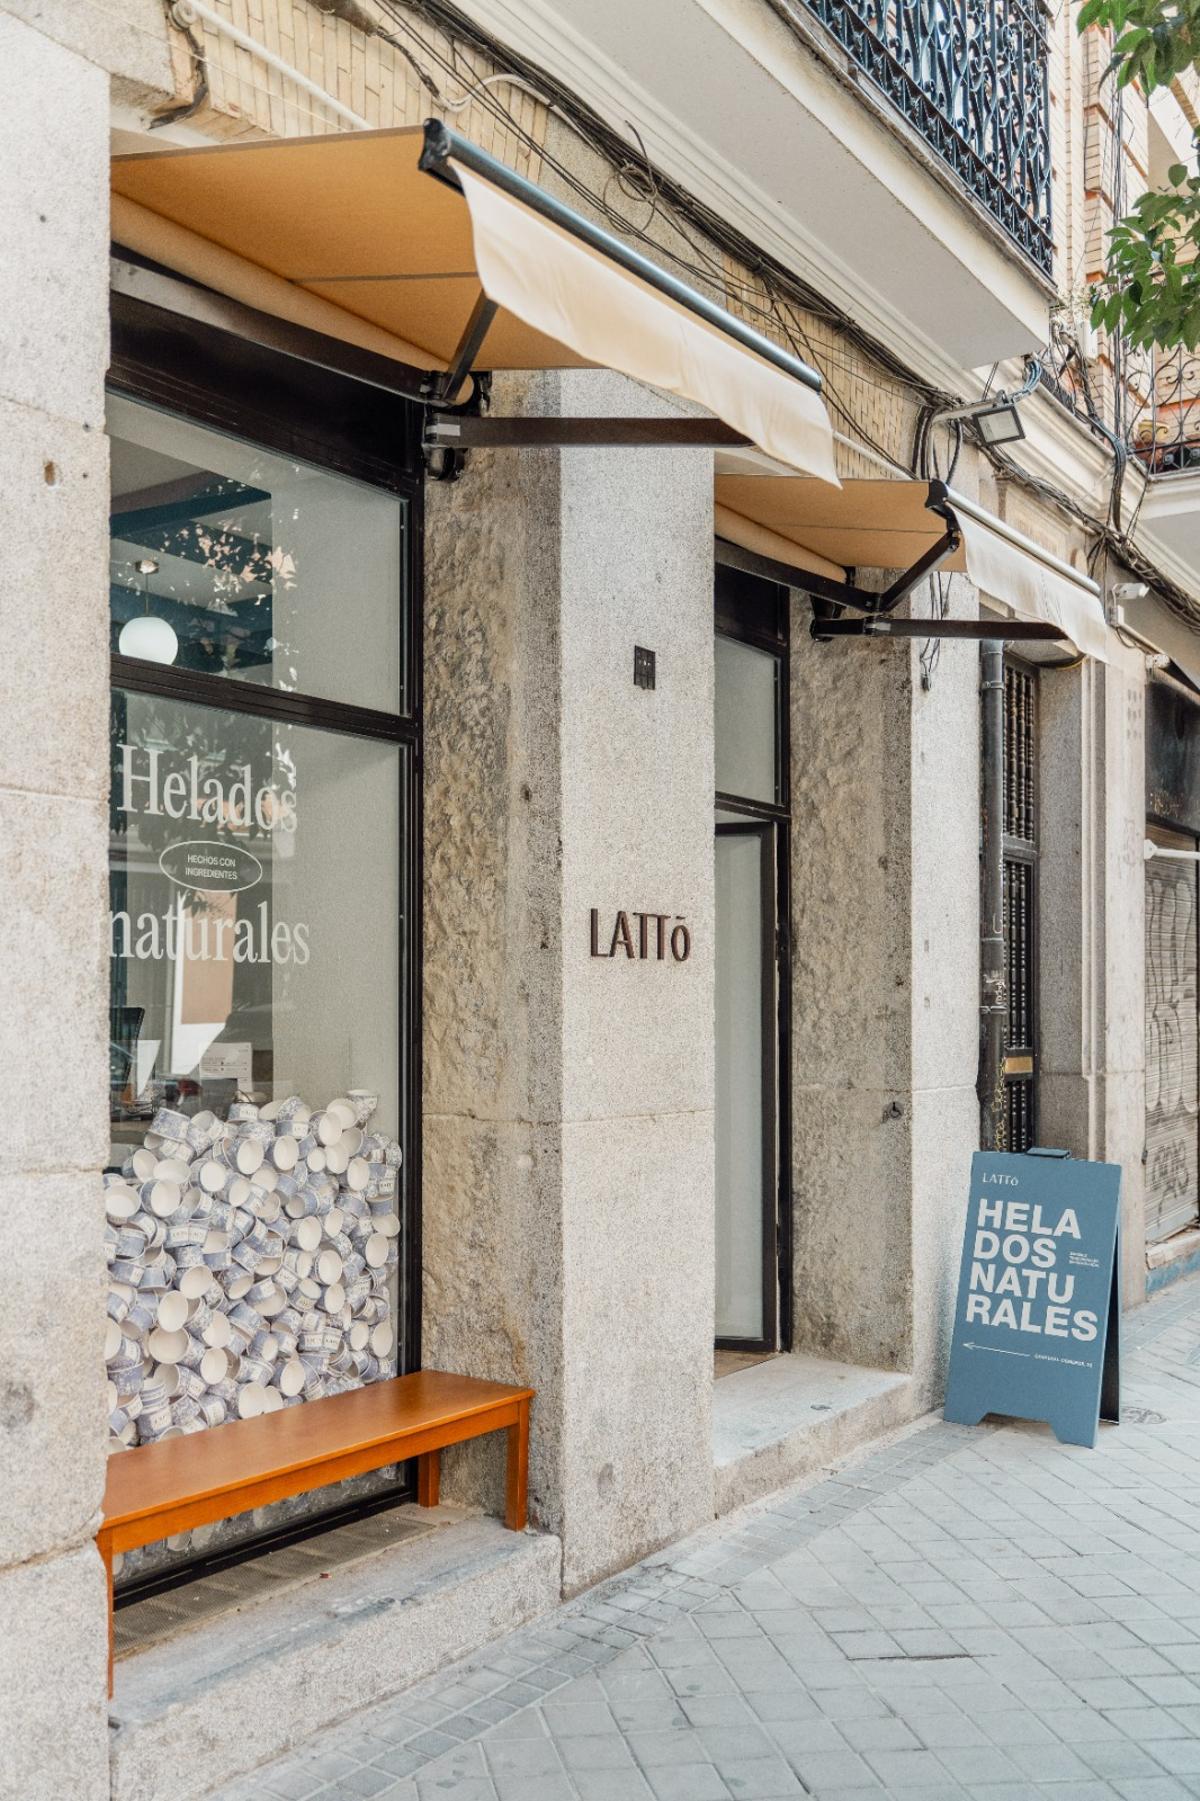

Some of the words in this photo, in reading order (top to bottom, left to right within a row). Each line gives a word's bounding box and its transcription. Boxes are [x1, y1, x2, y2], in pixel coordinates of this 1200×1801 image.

[116, 743, 298, 833] Helados
[185, 866, 238, 881] INGREDIENTES
[187, 853, 219, 866] HECHOS
[219, 857, 236, 868] CON
[109, 901, 311, 966] naturales
[976, 1198, 1082, 1240] HELA
[973, 1229, 1057, 1269] DOS
[969, 1261, 1076, 1304] NATU
[965, 1293, 1098, 1342] RALES
